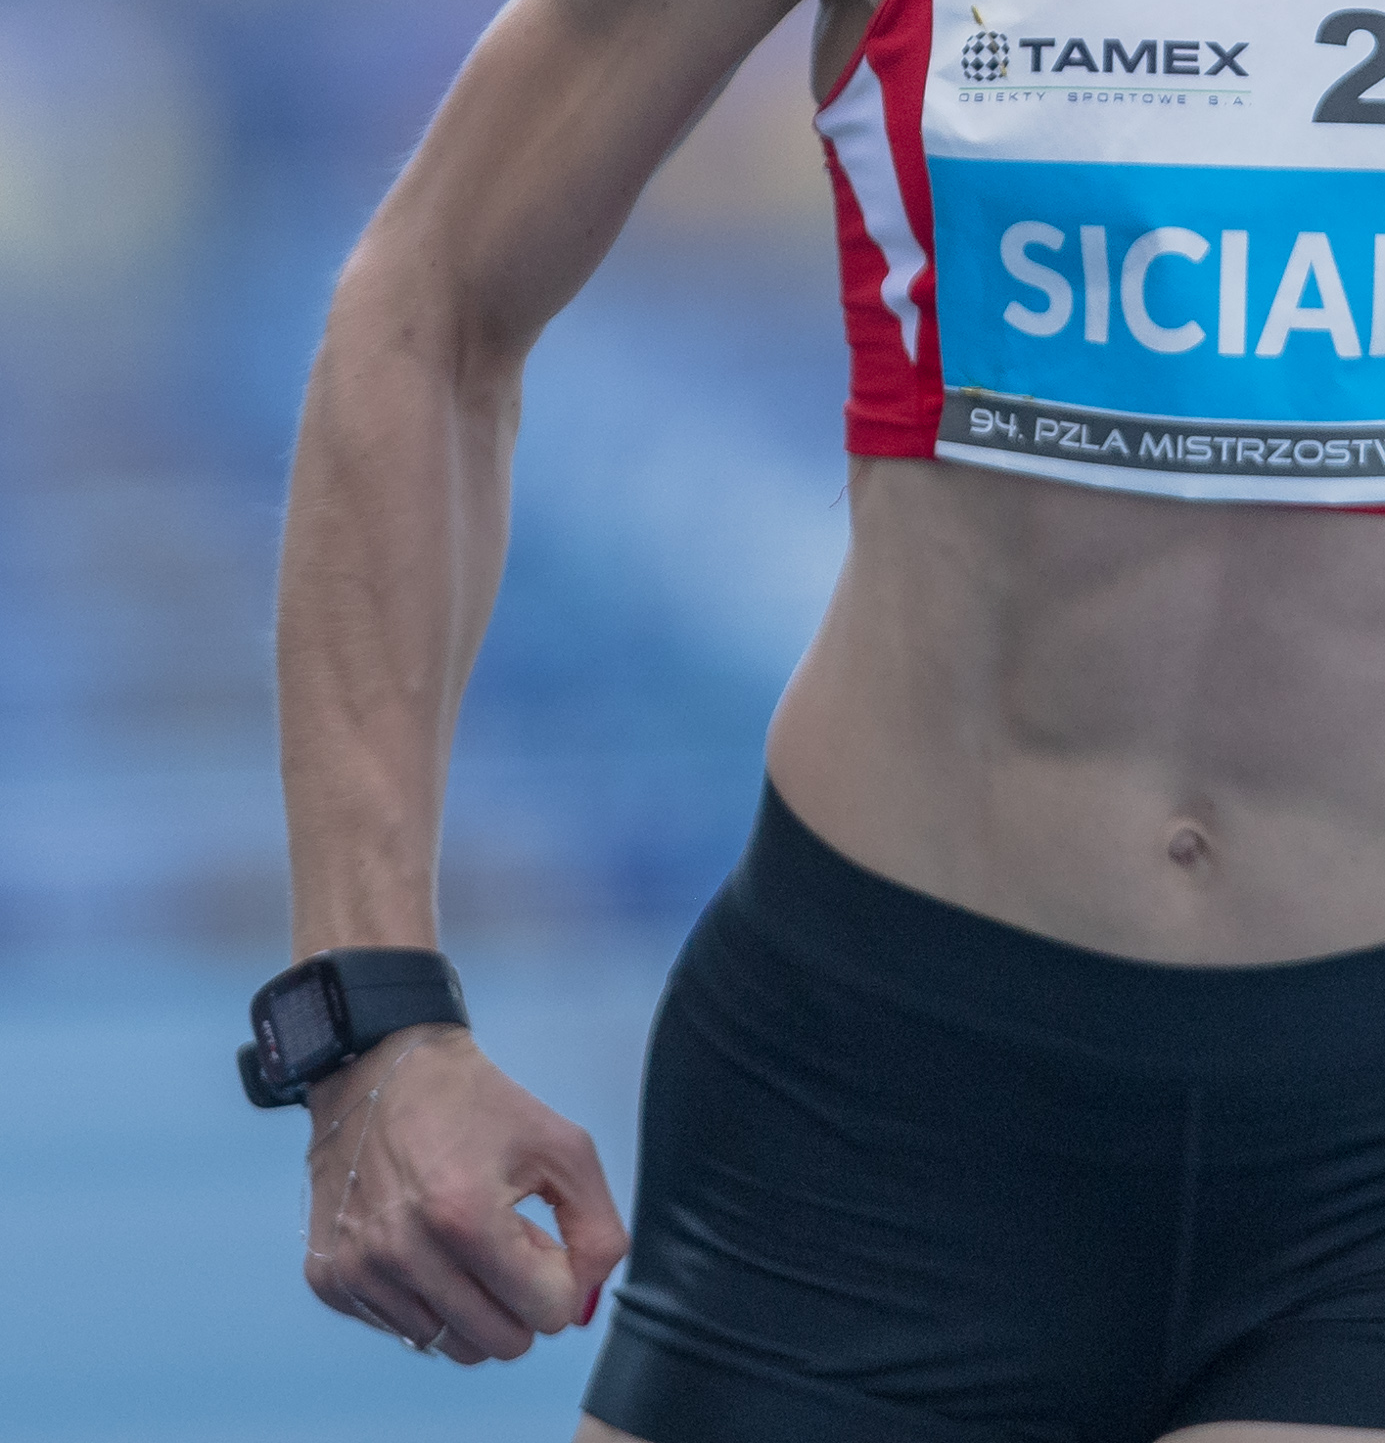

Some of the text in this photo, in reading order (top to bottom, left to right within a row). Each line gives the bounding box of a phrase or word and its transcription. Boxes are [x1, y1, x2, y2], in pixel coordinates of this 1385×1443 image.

[1019, 37, 1250, 77] TAMEX
[958, 91, 1047, 103] OBIEKTY
[1067, 91, 1187, 105] SPORTOWE
[969, 407, 1025, 440] 94.
[1034, 418, 1130, 456] PZLA
